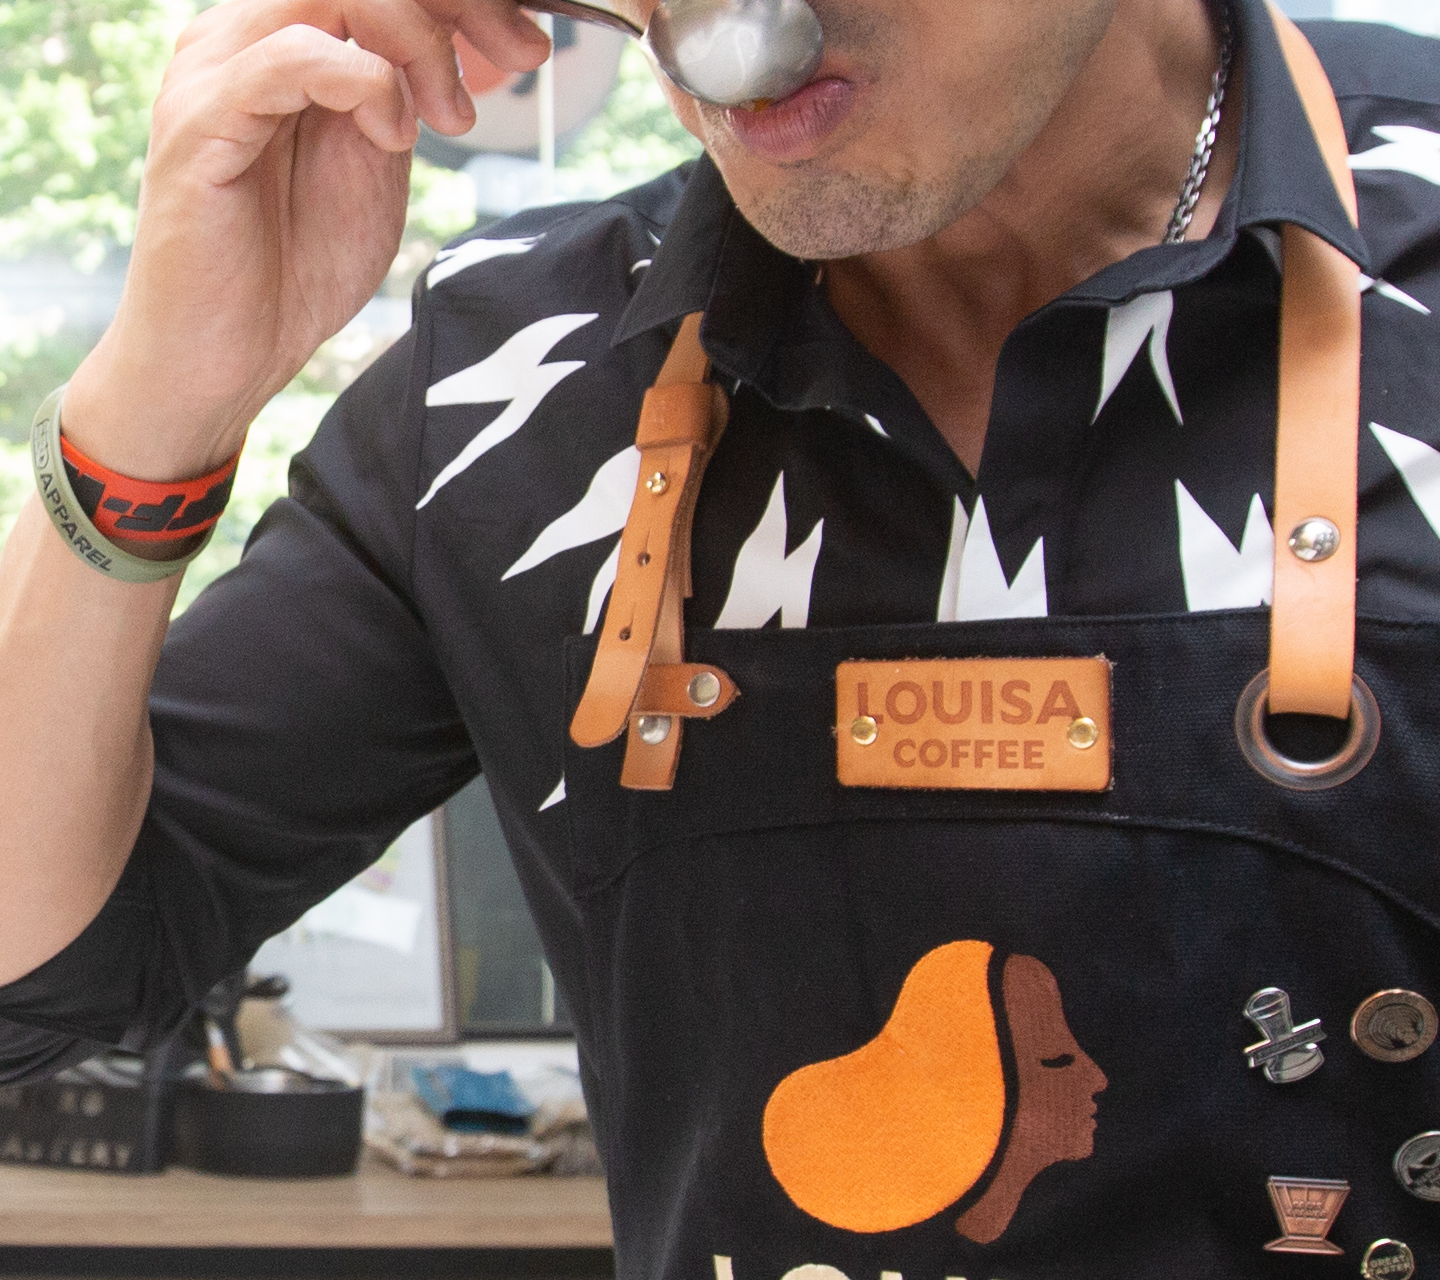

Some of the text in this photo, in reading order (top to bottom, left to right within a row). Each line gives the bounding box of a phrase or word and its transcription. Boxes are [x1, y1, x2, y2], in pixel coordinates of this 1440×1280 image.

[38, 472, 113, 572] APPAREL
[857, 678, 1084, 726] LOUISA
[892, 738, 1045, 770] COFFEE
